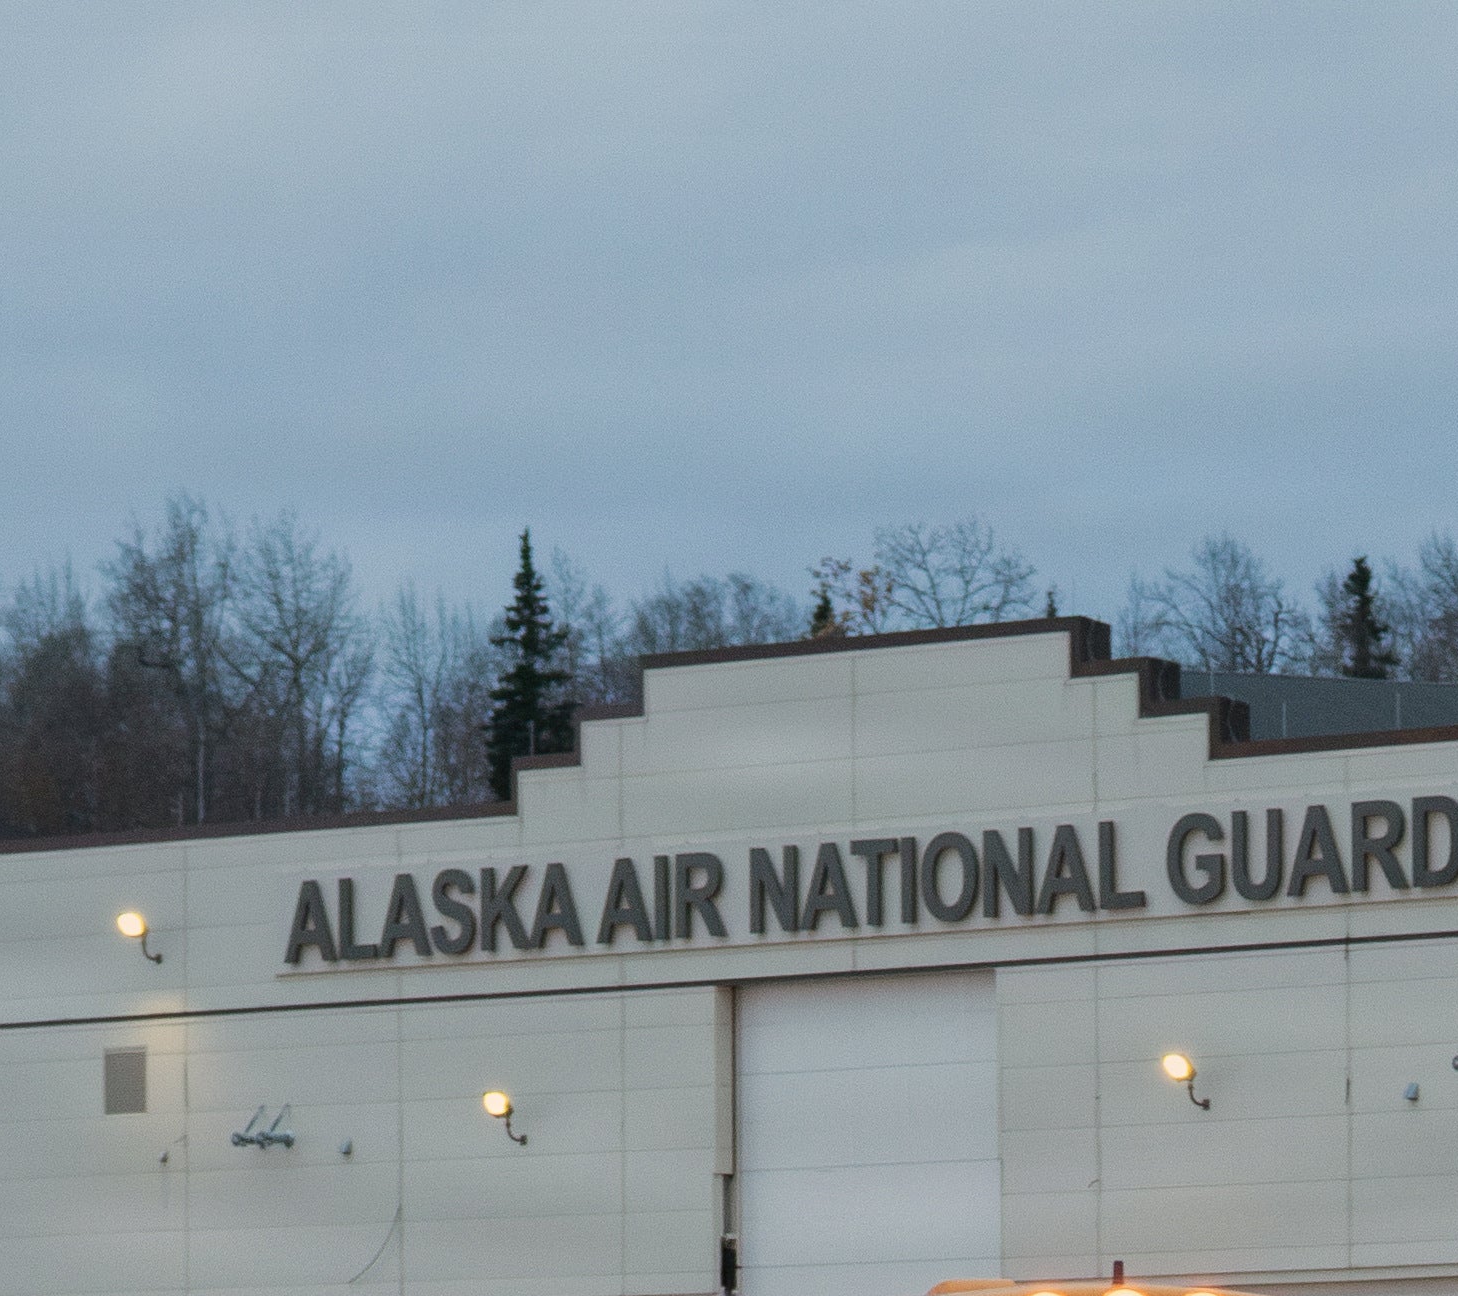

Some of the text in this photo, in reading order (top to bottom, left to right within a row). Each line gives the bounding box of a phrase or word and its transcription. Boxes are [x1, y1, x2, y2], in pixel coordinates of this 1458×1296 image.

[284, 861, 583, 964] ALASKA
[597, 851, 729, 944] AIR
[748, 819, 1146, 934] NATIONAL
